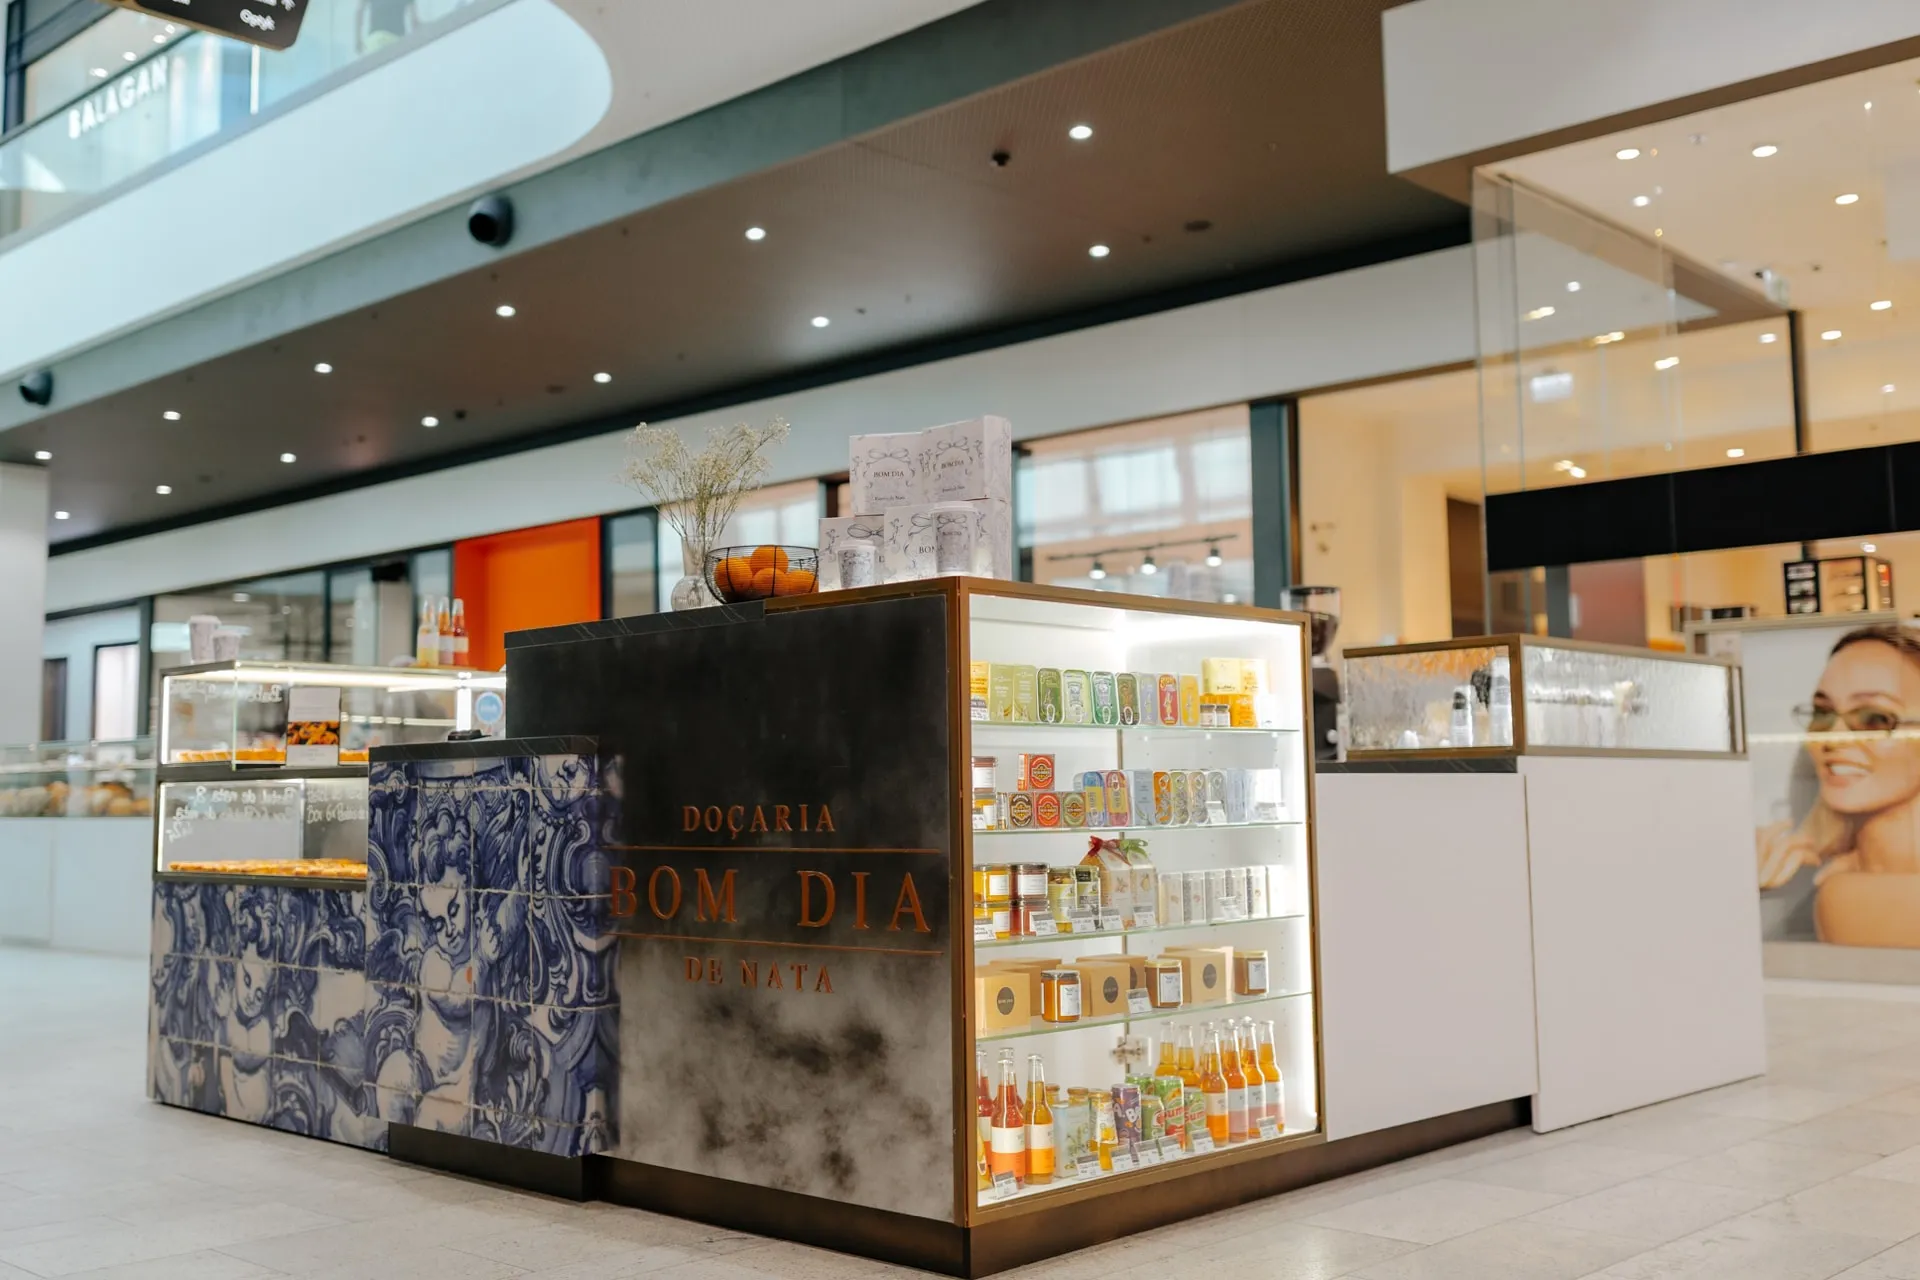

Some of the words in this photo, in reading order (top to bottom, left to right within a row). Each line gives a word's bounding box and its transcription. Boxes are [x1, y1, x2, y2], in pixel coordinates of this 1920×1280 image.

[68, 56, 168, 139] BALAGAN
[683, 804, 836, 839] DOÇARIA
[609, 865, 738, 923] BOM
[797, 870, 932, 933] DIA
[684, 956, 723, 984] DE
[740, 959, 834, 994] NATA
